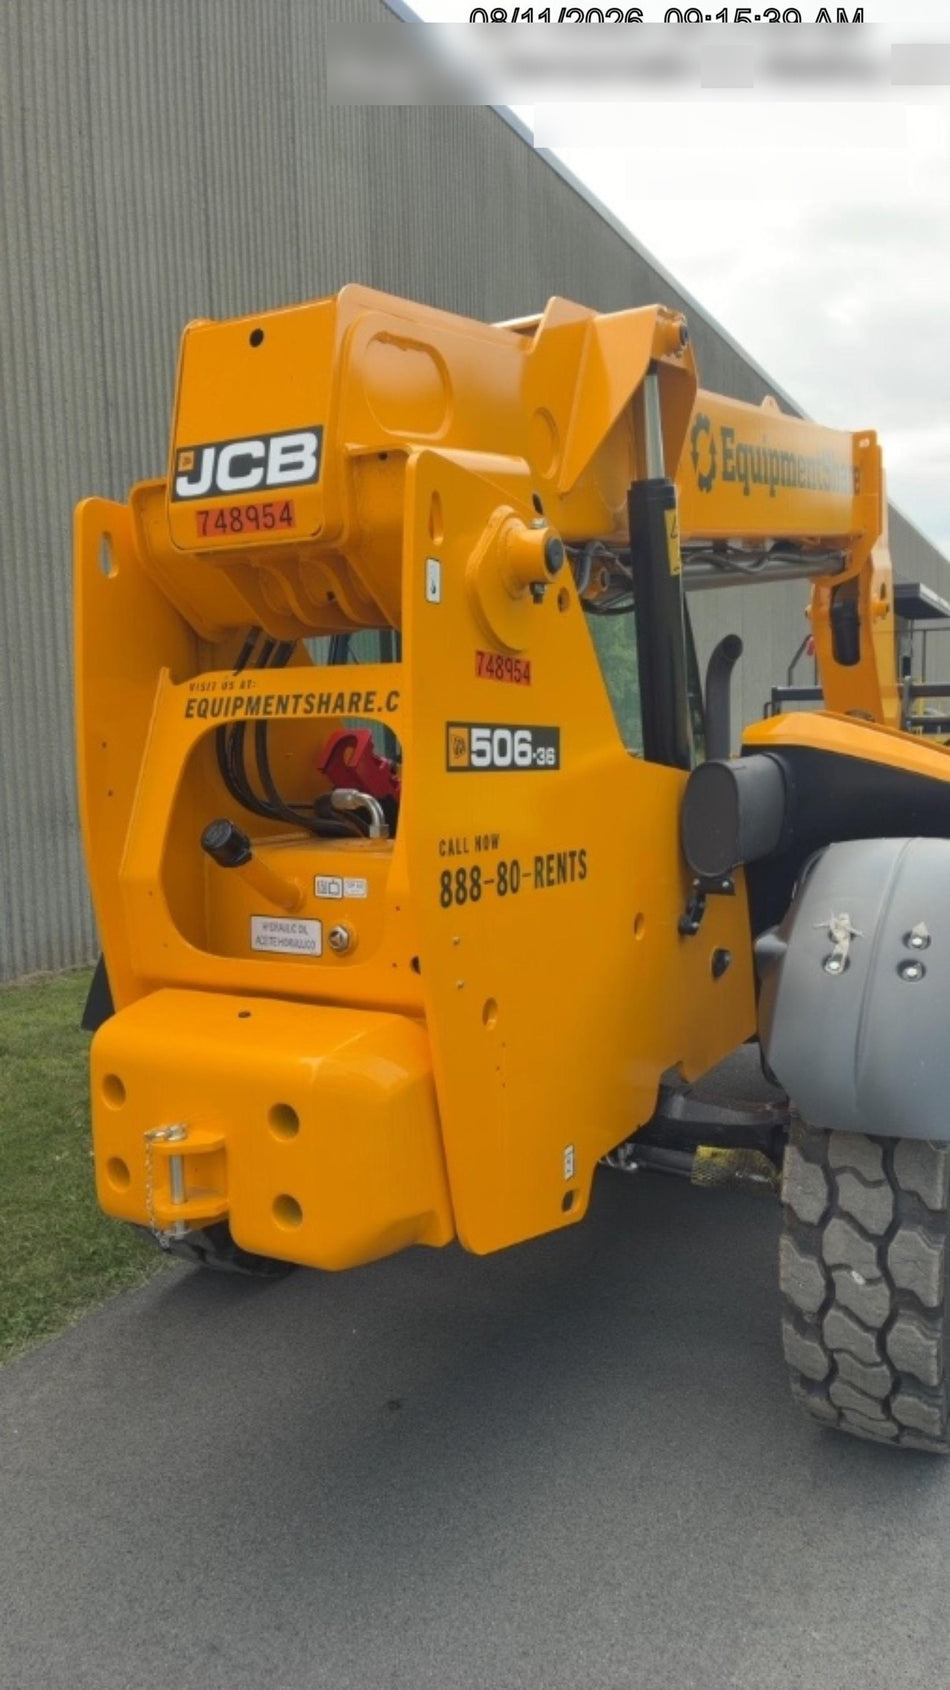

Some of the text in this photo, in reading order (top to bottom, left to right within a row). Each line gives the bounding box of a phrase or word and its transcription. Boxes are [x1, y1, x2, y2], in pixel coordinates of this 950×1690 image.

[176, 432, 317, 497] JCB
[197, 501, 293, 536] 748954
[189, 679, 256, 692] VISIT US AT:
[476, 650, 531, 686] 748954
[439, 833, 500, 857] CALL NOW
[440, 848, 587, 909] 888-80-RENTS
